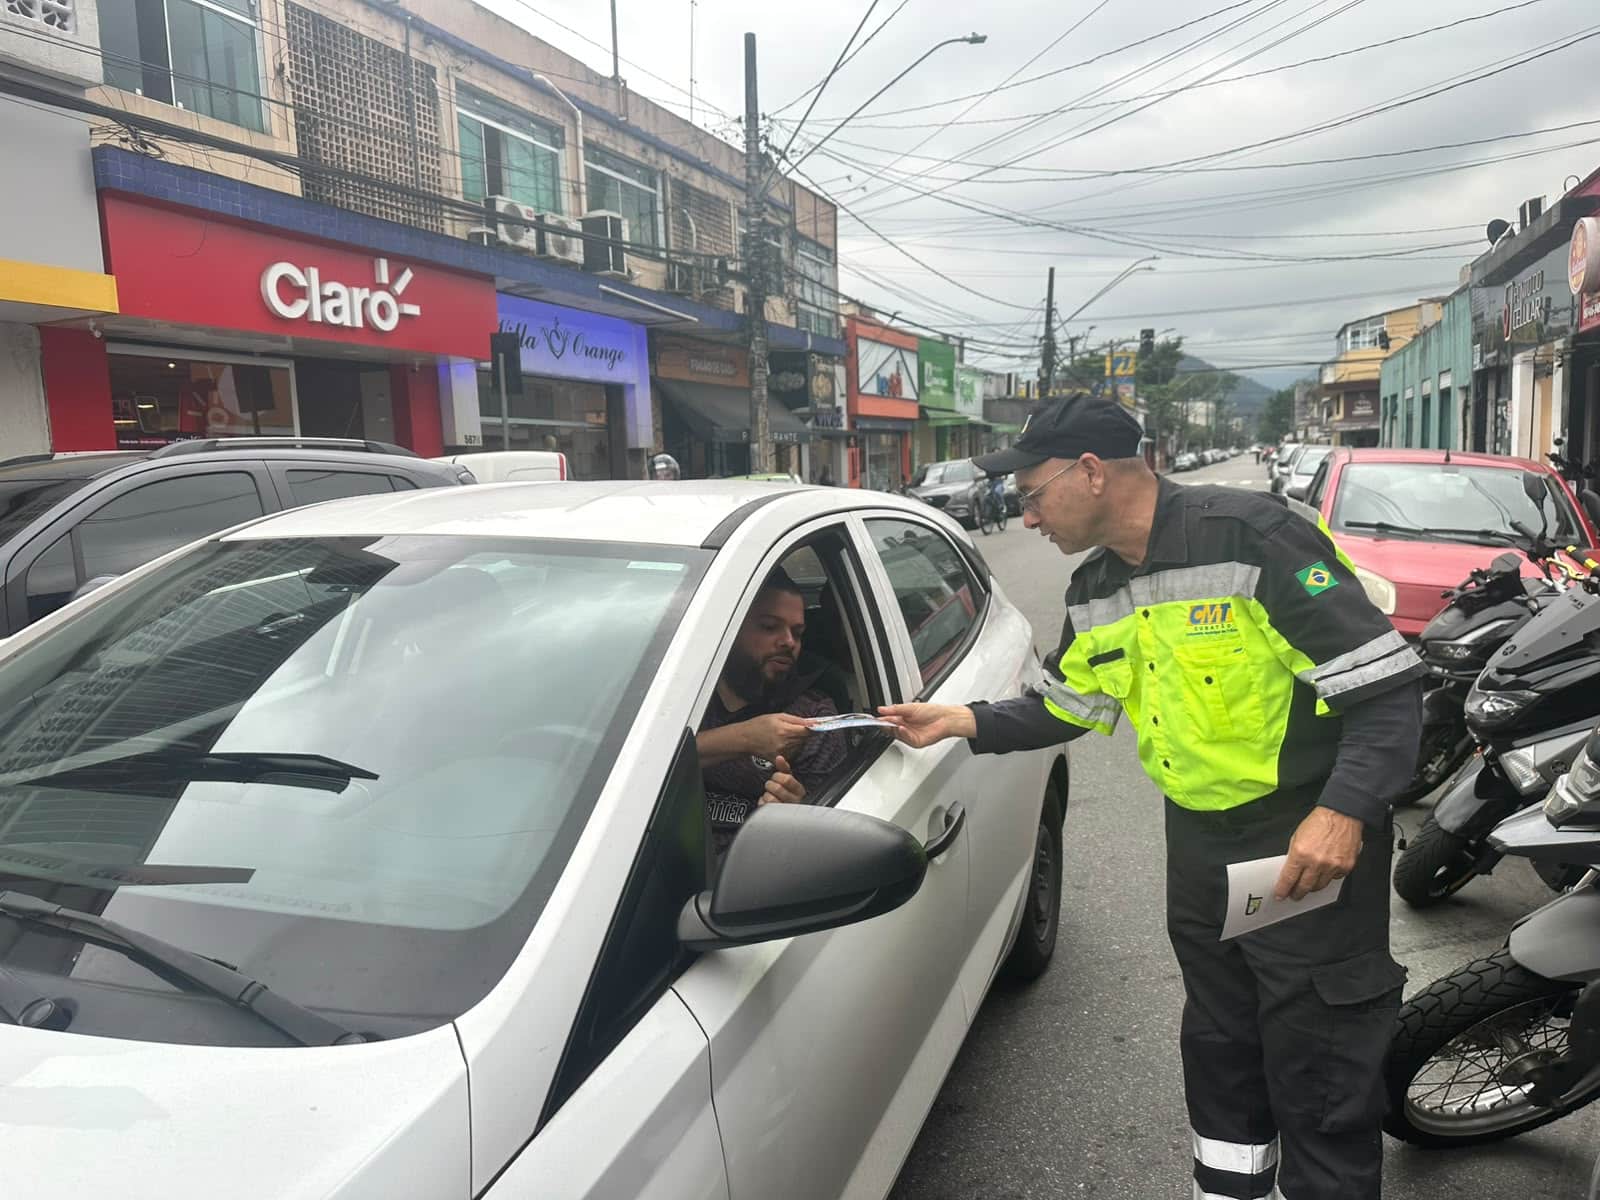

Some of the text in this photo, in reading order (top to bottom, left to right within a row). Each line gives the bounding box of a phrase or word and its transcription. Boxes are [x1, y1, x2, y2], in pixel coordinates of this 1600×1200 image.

[260, 261, 400, 332] Claro
[573, 333, 625, 371] Orange
[1190, 603, 1231, 625] CMT
